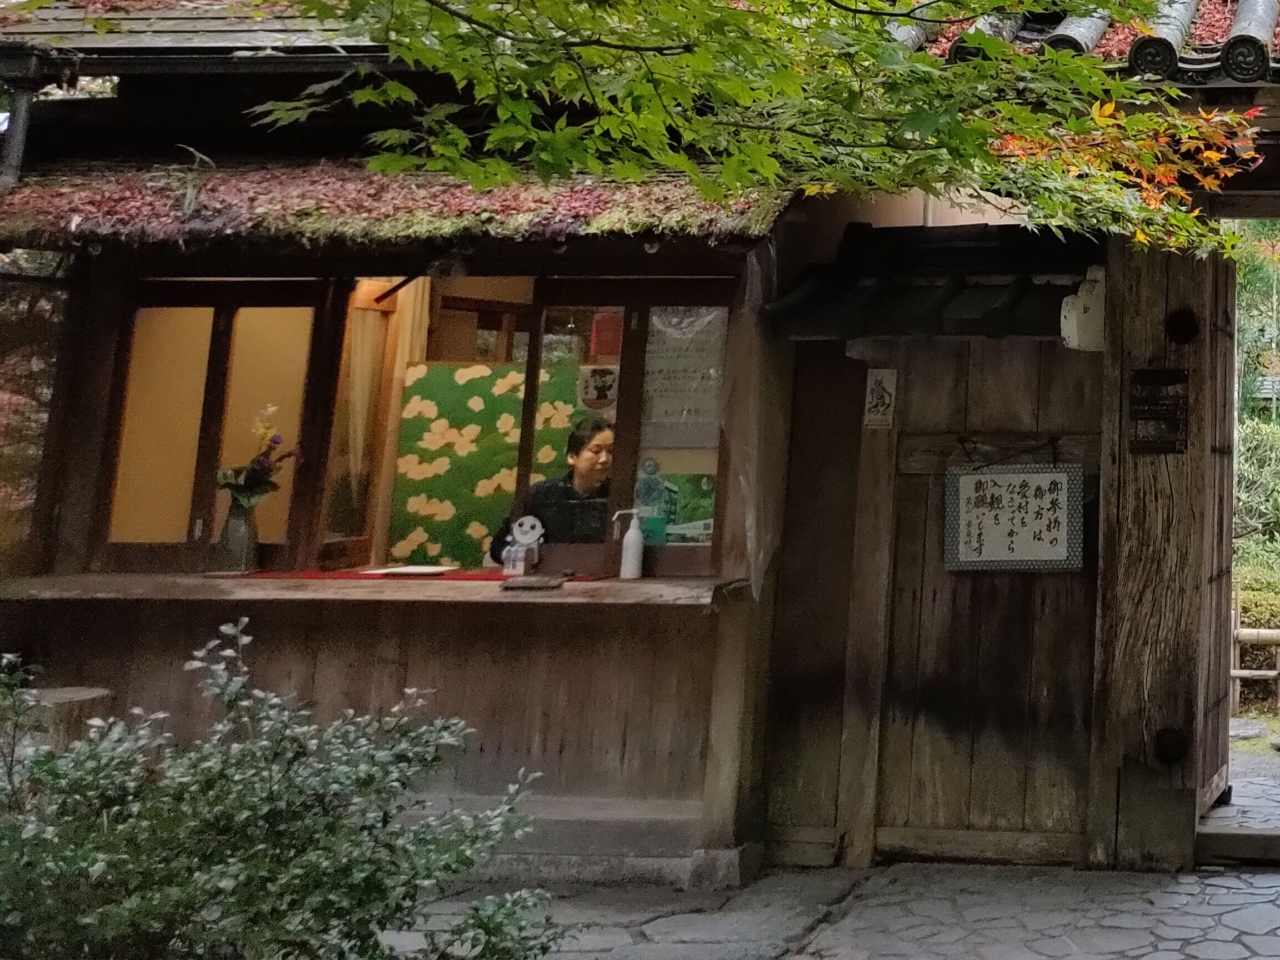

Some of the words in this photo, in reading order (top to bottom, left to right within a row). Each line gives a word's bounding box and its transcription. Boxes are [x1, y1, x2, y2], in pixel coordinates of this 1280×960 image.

[972, 478, 989, 558] 御願いします
[1045, 479, 1063, 548] 御参拝の
